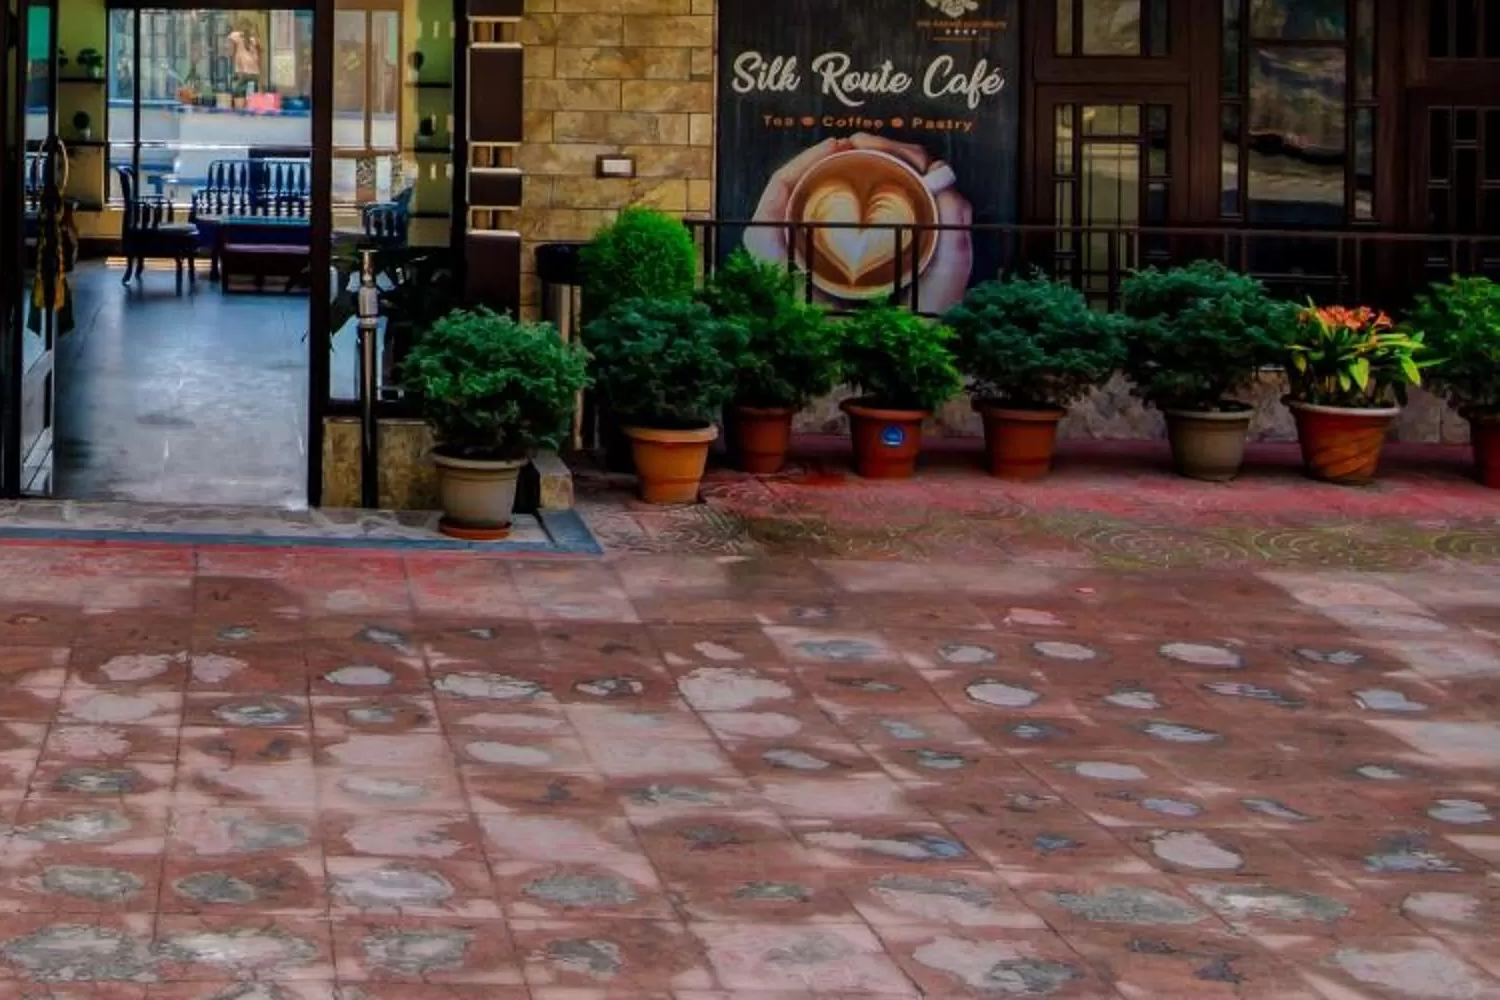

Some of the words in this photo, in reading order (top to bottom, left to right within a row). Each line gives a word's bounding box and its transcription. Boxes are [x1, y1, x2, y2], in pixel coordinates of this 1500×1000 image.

[731, 51, 801, 93] Silk
[811, 51, 913, 107] Route
[923, 54, 1005, 110] Café
[763, 114, 794, 127] Tea
[821, 115, 884, 129] Coffee
[911, 117, 973, 132] Pastry
